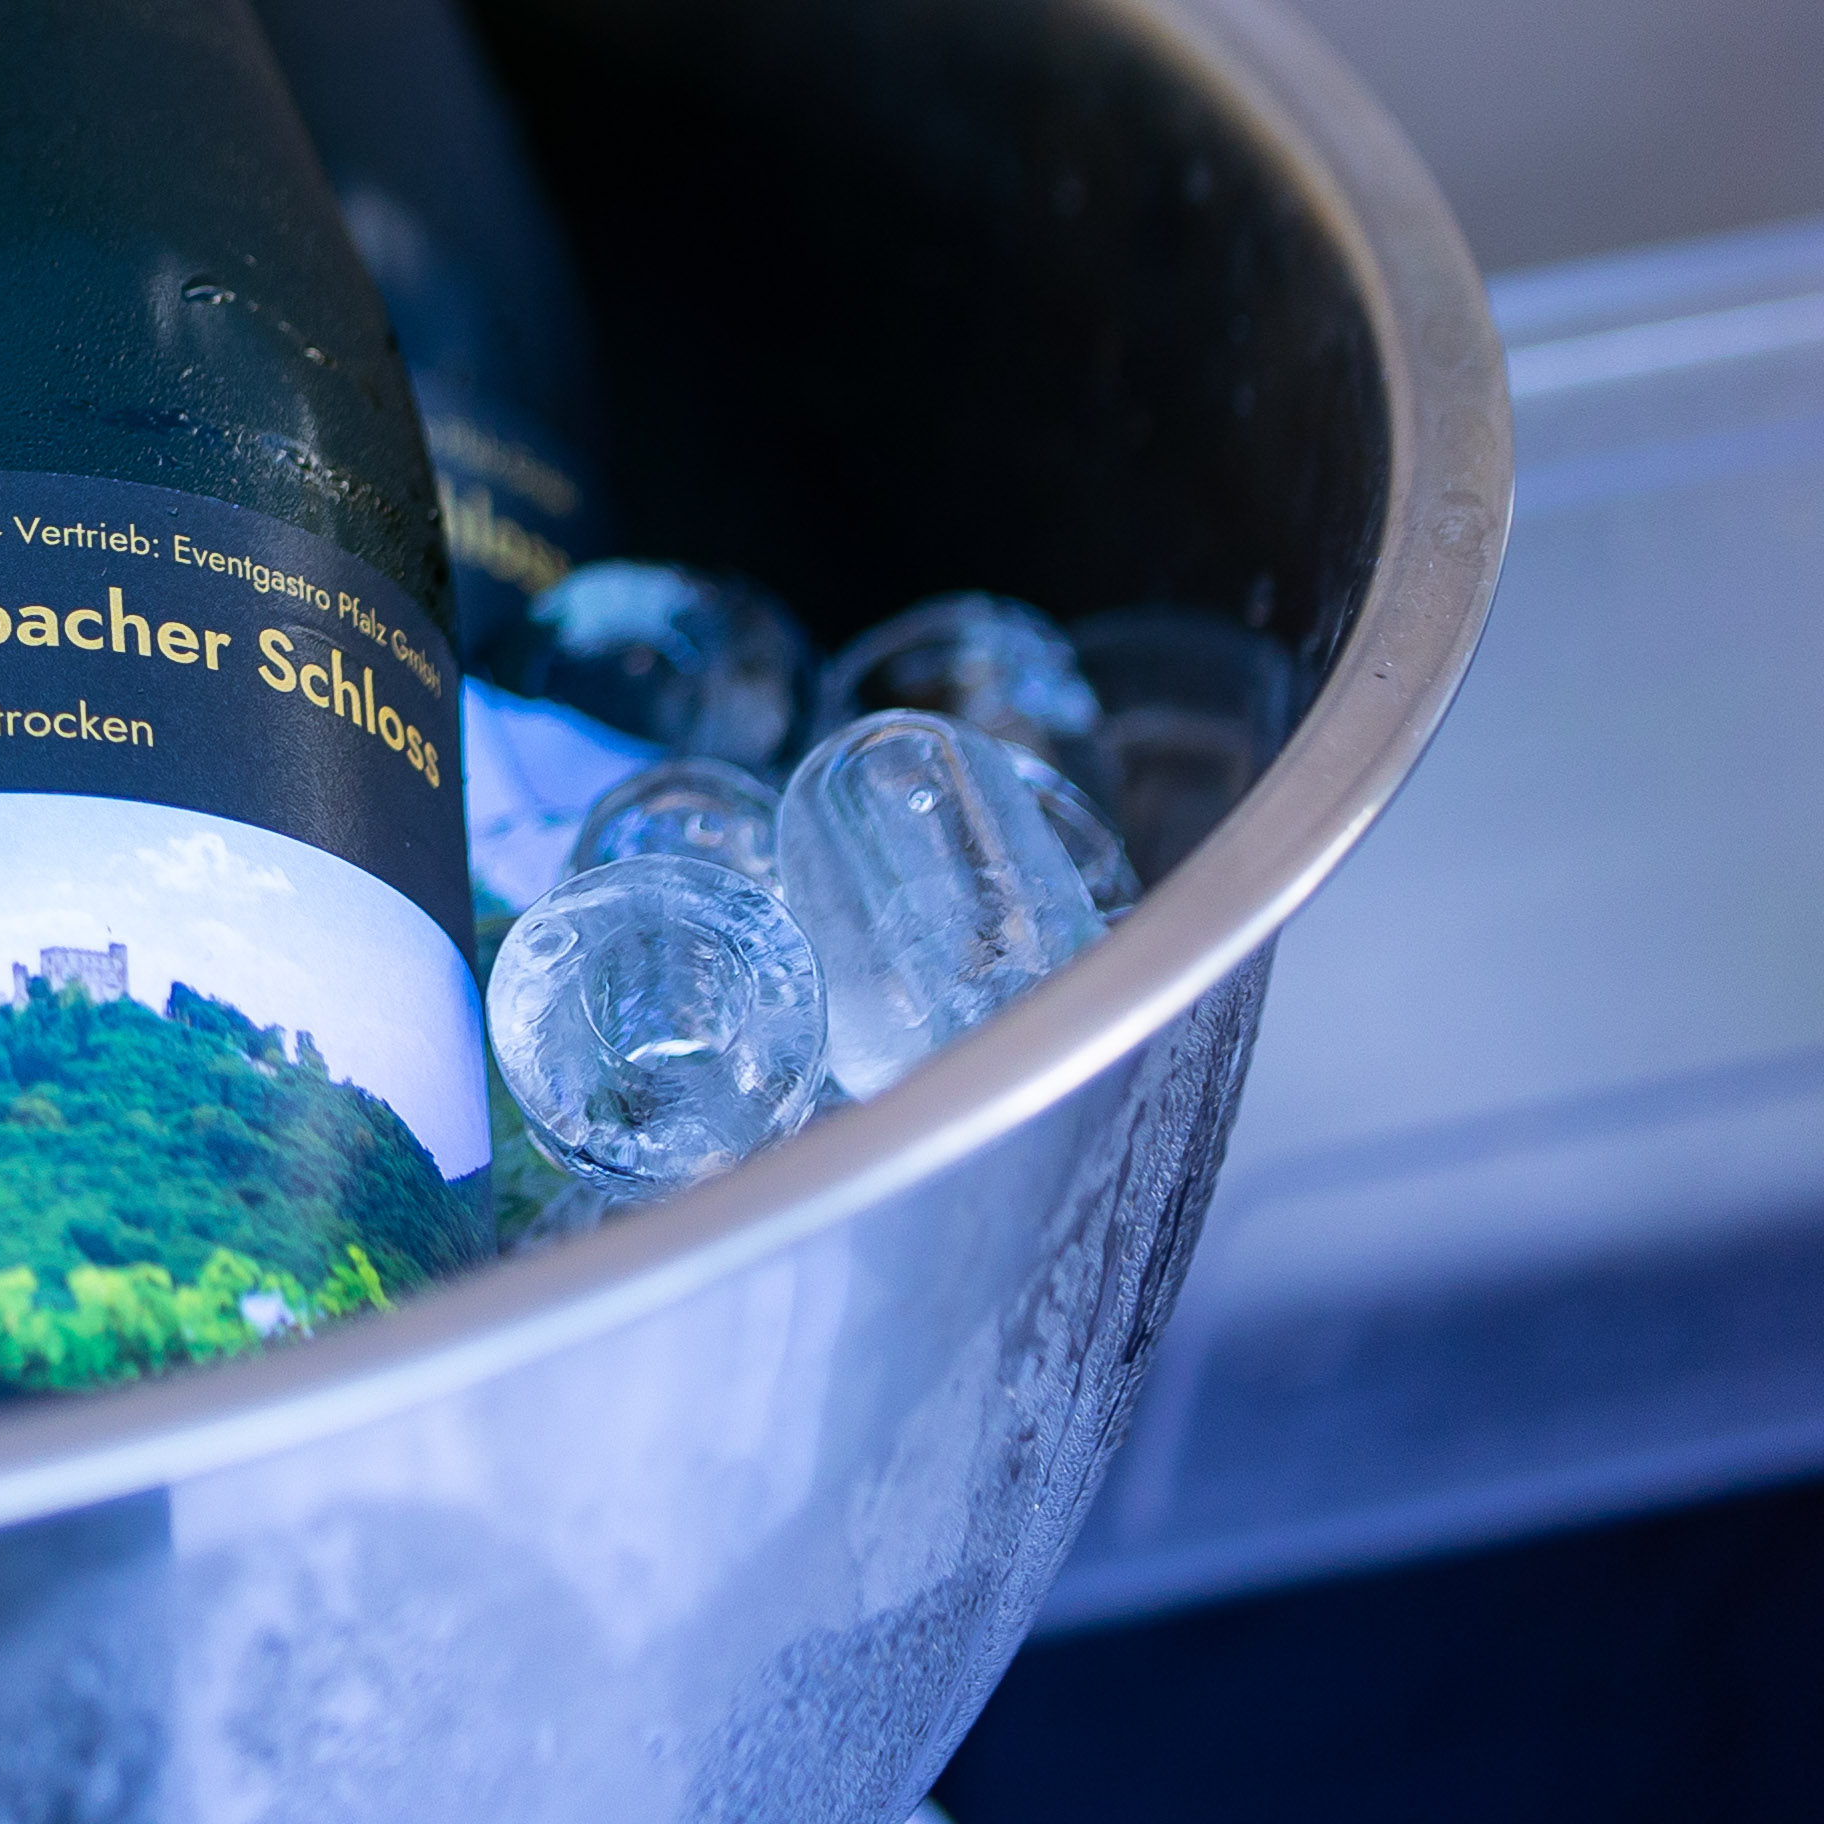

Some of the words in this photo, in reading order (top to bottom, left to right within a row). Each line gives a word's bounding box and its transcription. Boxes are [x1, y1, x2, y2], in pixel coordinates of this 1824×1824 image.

[13, 517, 159, 558] Vertrieb:
[173, 535, 330, 611] Eventgastro
[338, 592, 387, 647] Pfalz
[392, 629, 442, 698] GmbH
[257, 628, 441, 789] Schloss
